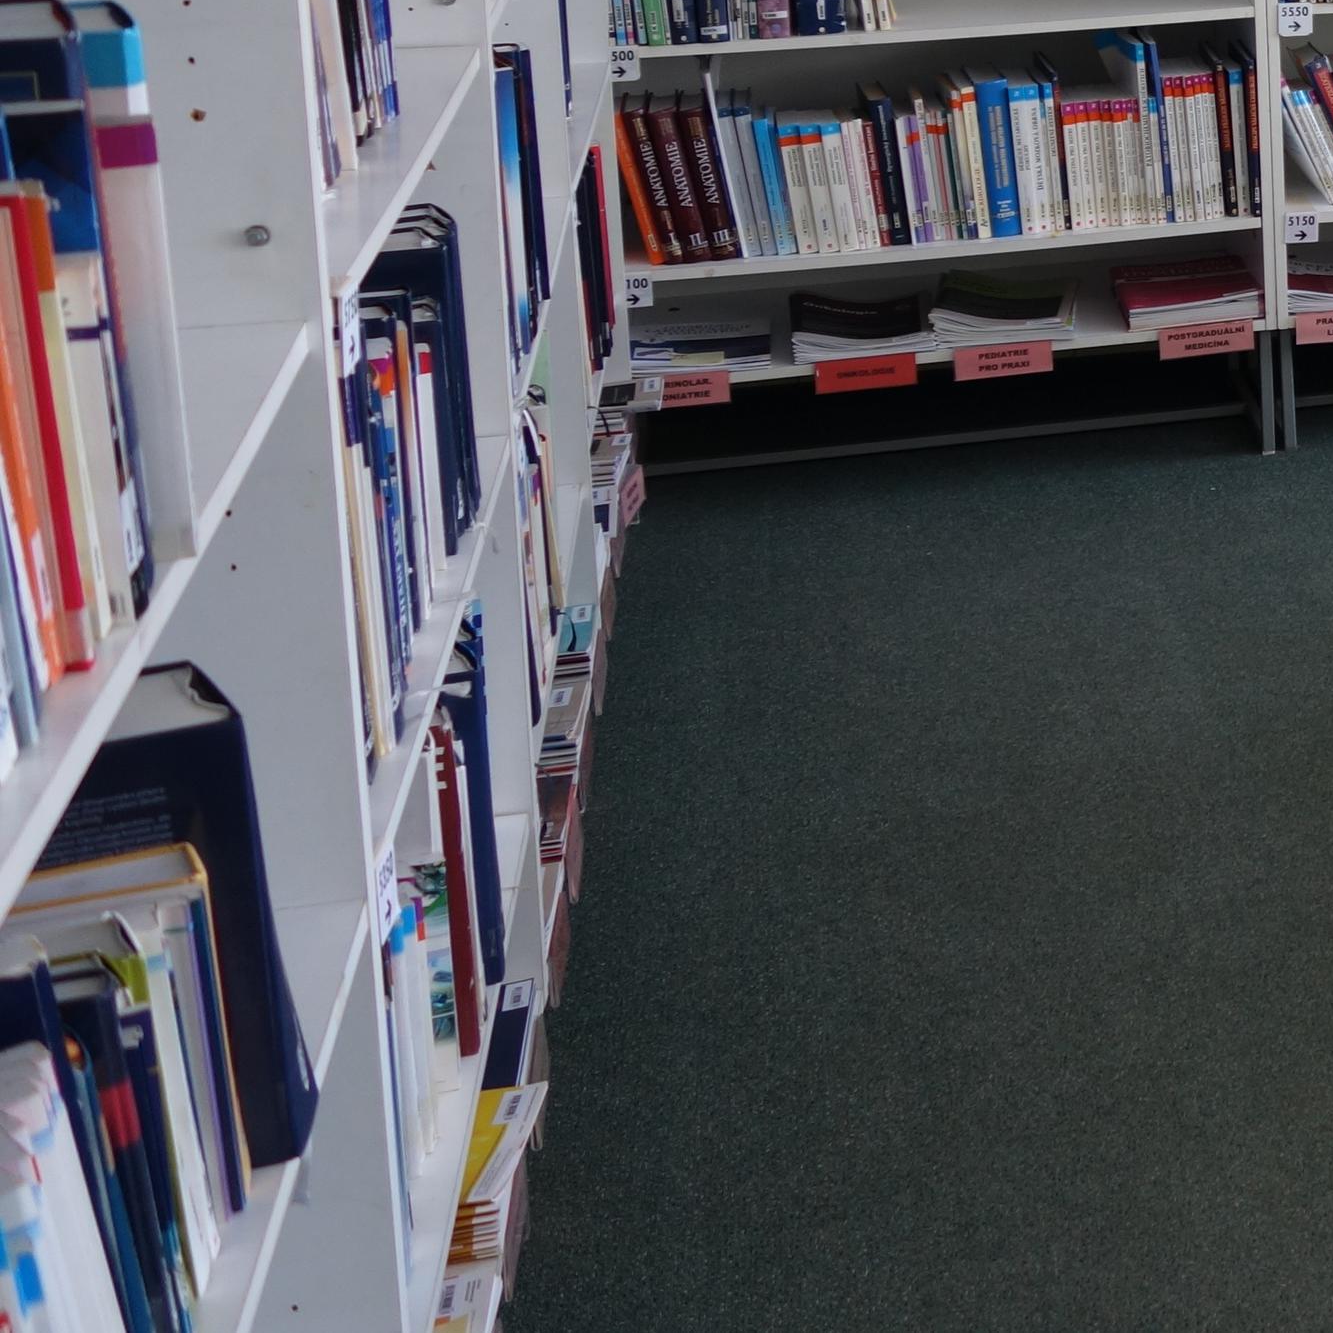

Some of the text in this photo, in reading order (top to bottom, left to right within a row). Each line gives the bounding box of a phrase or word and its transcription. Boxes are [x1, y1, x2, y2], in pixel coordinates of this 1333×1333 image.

[1281, 6, 1309, 17] 5550
[611, 50, 634, 62] 500
[640, 140, 668, 207] ANATOMIE
[665, 141, 693, 207] ANATOMIE
[693, 138, 720, 204] ANATOMIE
[1287, 216, 1315, 227] 5150
[625, 277, 648, 290] 100
[1168, 326, 1245, 341] POSTGRADUÁLNÍ
[1185, 339, 1230, 351] MEDICÍNA
[978, 349, 1029, 360] PEDIATRIE
[979, 361, 1030, 372] PRO PRAXI
[664, 378, 712, 389] RINOLAR.
[663, 391, 711, 402] ONIATRIE
